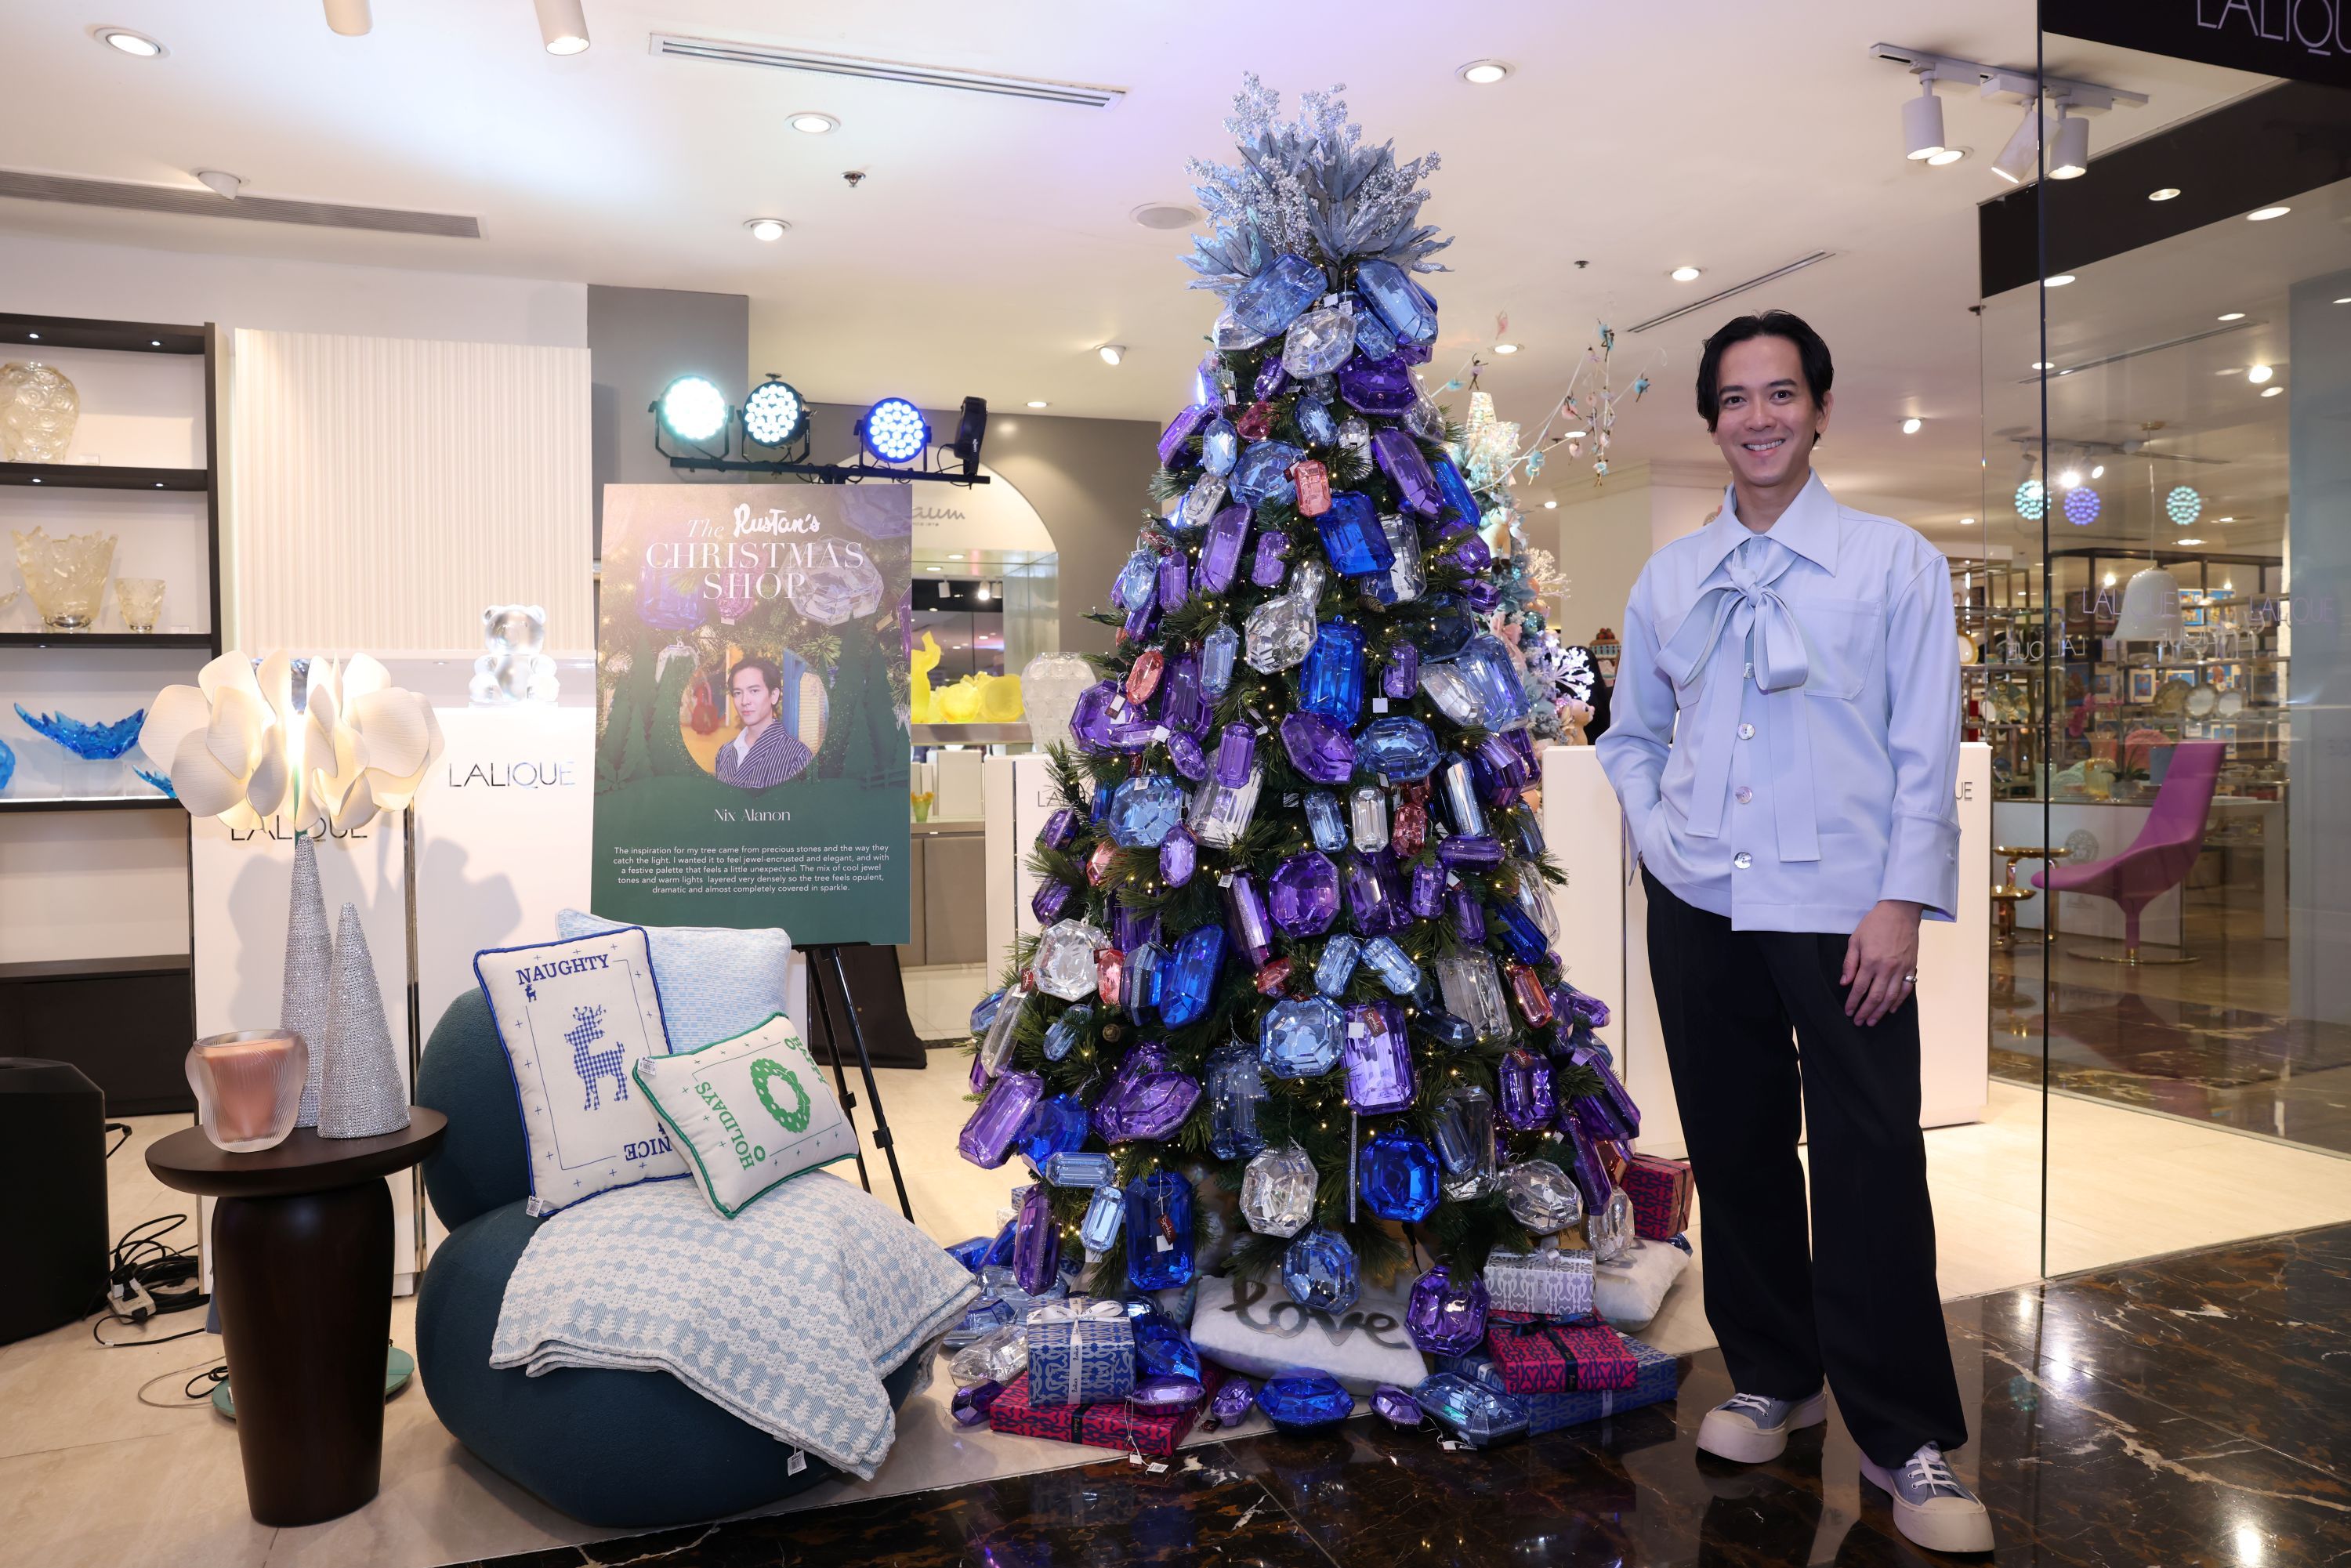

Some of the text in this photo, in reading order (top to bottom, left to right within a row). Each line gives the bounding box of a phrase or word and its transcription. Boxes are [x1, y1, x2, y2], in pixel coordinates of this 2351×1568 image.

[687, 519, 724, 538] The
[646, 541, 864, 569] CHRISTMAS
[703, 573, 806, 599] SHOP
[2250, 596, 2335, 625] LALQUE
[448, 761, 577, 789] LALIQUE
[714, 809, 791, 821] Nix Alanon
[613, 856, 634, 864] catch
[636, 856, 650, 864] the
[651, 855, 671, 866] light.
[677, 855, 707, 864] wanted
[726, 855, 741, 864] feel
[742, 854, 805, 864] jewel-encrusted
[823, 853, 854, 863] elegant,
[872, 853, 889, 861] with
[631, 846, 672, 856] inspiration
[673, 846, 685, 854] for
[741, 844, 759, 853] from
[761, 846, 795, 855] precious
[823, 844, 839, 853] and
[871, 843, 889, 853] they
[641, 876, 657, 885] and
[682, 875, 704, 885] lights
[708, 875, 737, 885] layered
[738, 876, 755, 885] very
[756, 874, 787, 884] densely
[799, 874, 813, 882] the
[831, 872, 850, 882] feels
[852, 873, 884, 883] opulent,
[655, 865, 683, 875] palette
[685, 865, 701, 874] that
[703, 865, 722, 874] feels
[730, 864, 748, 874] little
[750, 864, 798, 875] unexpected.
[799, 864, 815, 872] The
[817, 864, 831, 872] mix
[832, 864, 841, 872] of
[842, 863, 859, 871] cool
[860, 863, 882, 873] jewel
[688, 885, 703, 893] and
[705, 885, 732, 893] almost
[733, 884, 777, 894] completely
[777, 883, 810, 893] covered
[820, 883, 850, 893] sparkle.
[516, 954, 610, 985] NAUGHTY
[791, 1036, 828, 1085] HAPPY
[695, 1081, 755, 1171] HOLIDAYS
[624, 1135, 672, 1161] NICE
[1220, 1279, 1411, 1350] love
